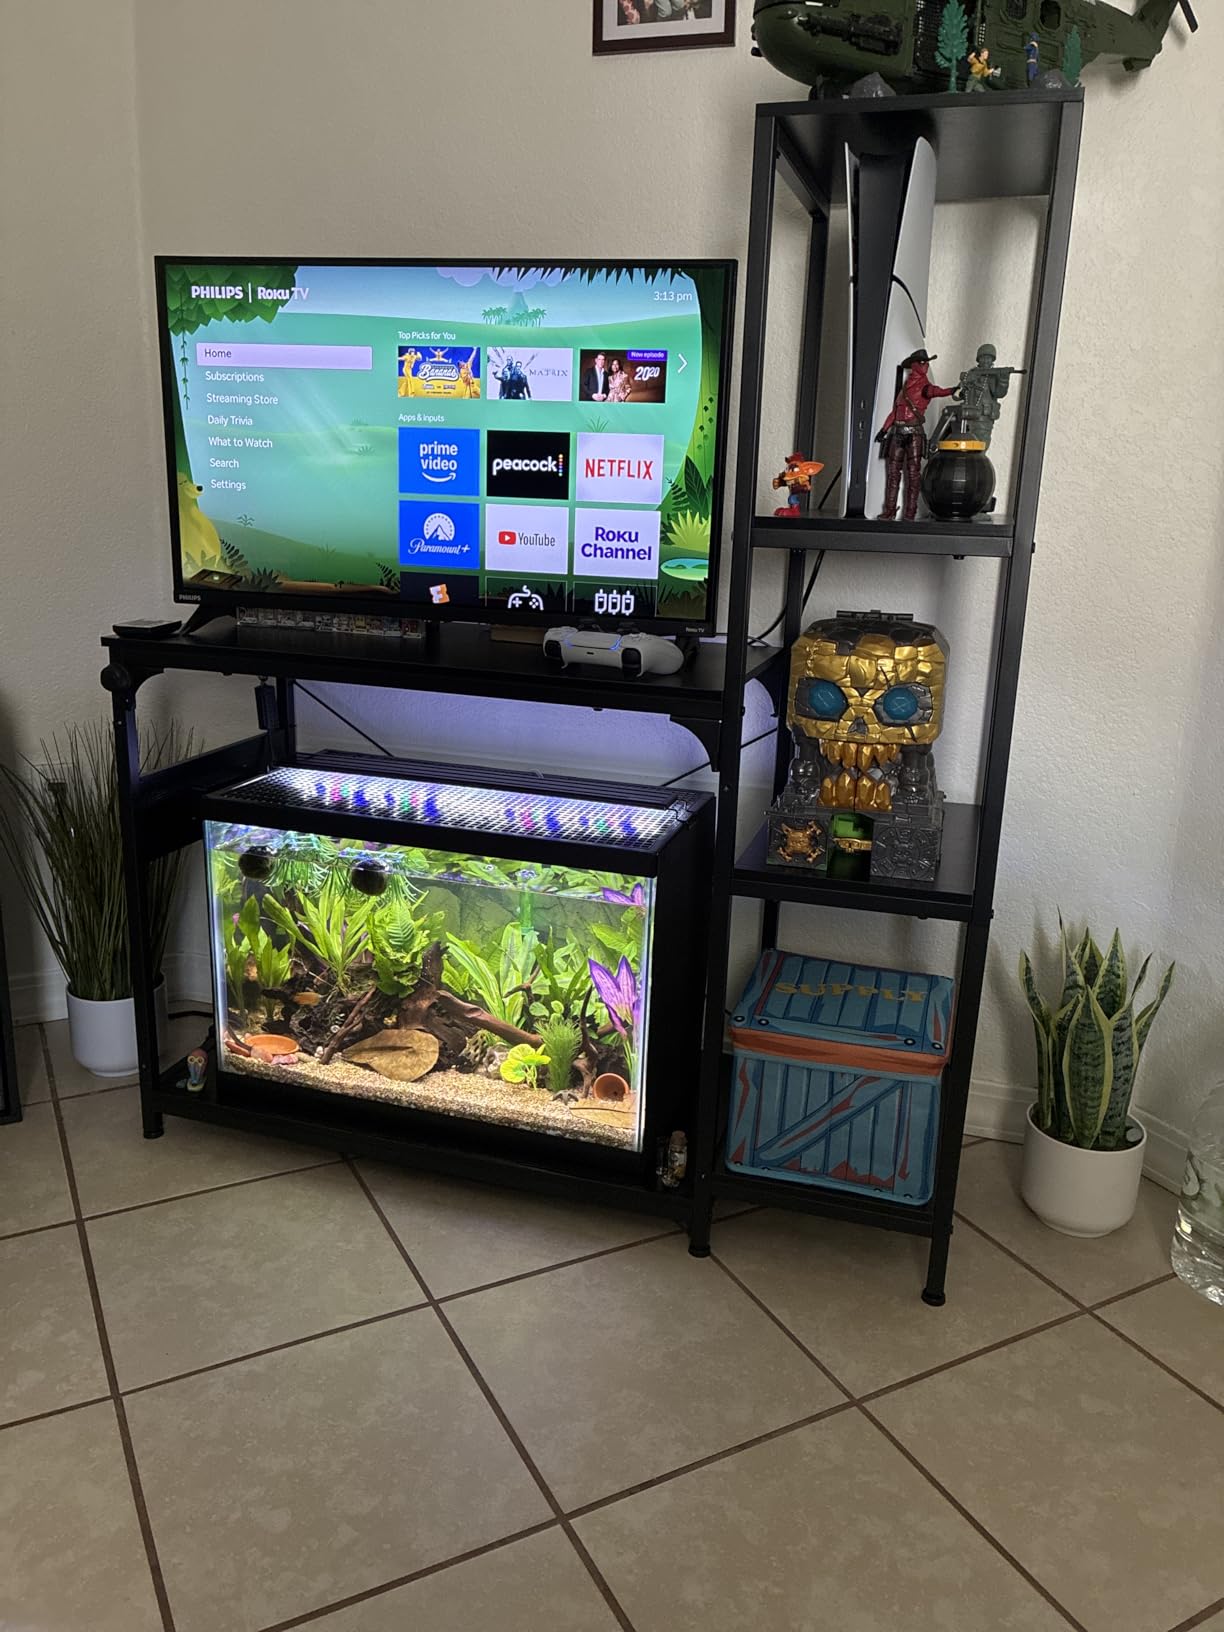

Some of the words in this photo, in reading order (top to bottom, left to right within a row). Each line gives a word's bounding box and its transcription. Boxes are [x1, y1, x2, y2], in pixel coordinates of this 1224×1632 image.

[191, 285, 243, 299] PHILIPS
[257, 286, 290, 300] Roku
[291, 287, 309, 300] TV
[653, 291, 675, 301] 3:13
[676, 294, 692, 303] pm
[398, 331, 411, 340] Top
[411, 331, 430, 340] Picks
[430, 331, 441, 340] for
[442, 332, 456, 340] You
[204, 348, 232, 358] Home
[205, 370, 265, 383] Subscriptions
[529, 368, 568, 377] MATRIX
[206, 393, 253, 406] Streaming
[253, 394, 279, 405] Store
[207, 415, 229, 427] Daily
[229, 416, 253, 426] Trivia
[398, 413, 416, 423] Apps
[416, 413, 423, 421] &
[208, 437, 232, 447] What
[233, 438, 243, 448] to
[244, 438, 273, 448] Watch
[419, 441, 459, 457] prime
[209, 458, 240, 469] Search
[420, 456, 458, 471] video
[492, 456, 558, 476] peacock
[585, 458, 653, 480] NETFLIX
[210, 479, 247, 492] Settings
[518, 532, 556, 547] YouTube
[594, 526, 639, 543] Roku
[407, 537, 471, 555] Paramount+
[581, 543, 652, 561] Channel
[775, 982, 928, 1003] SUPPLY
